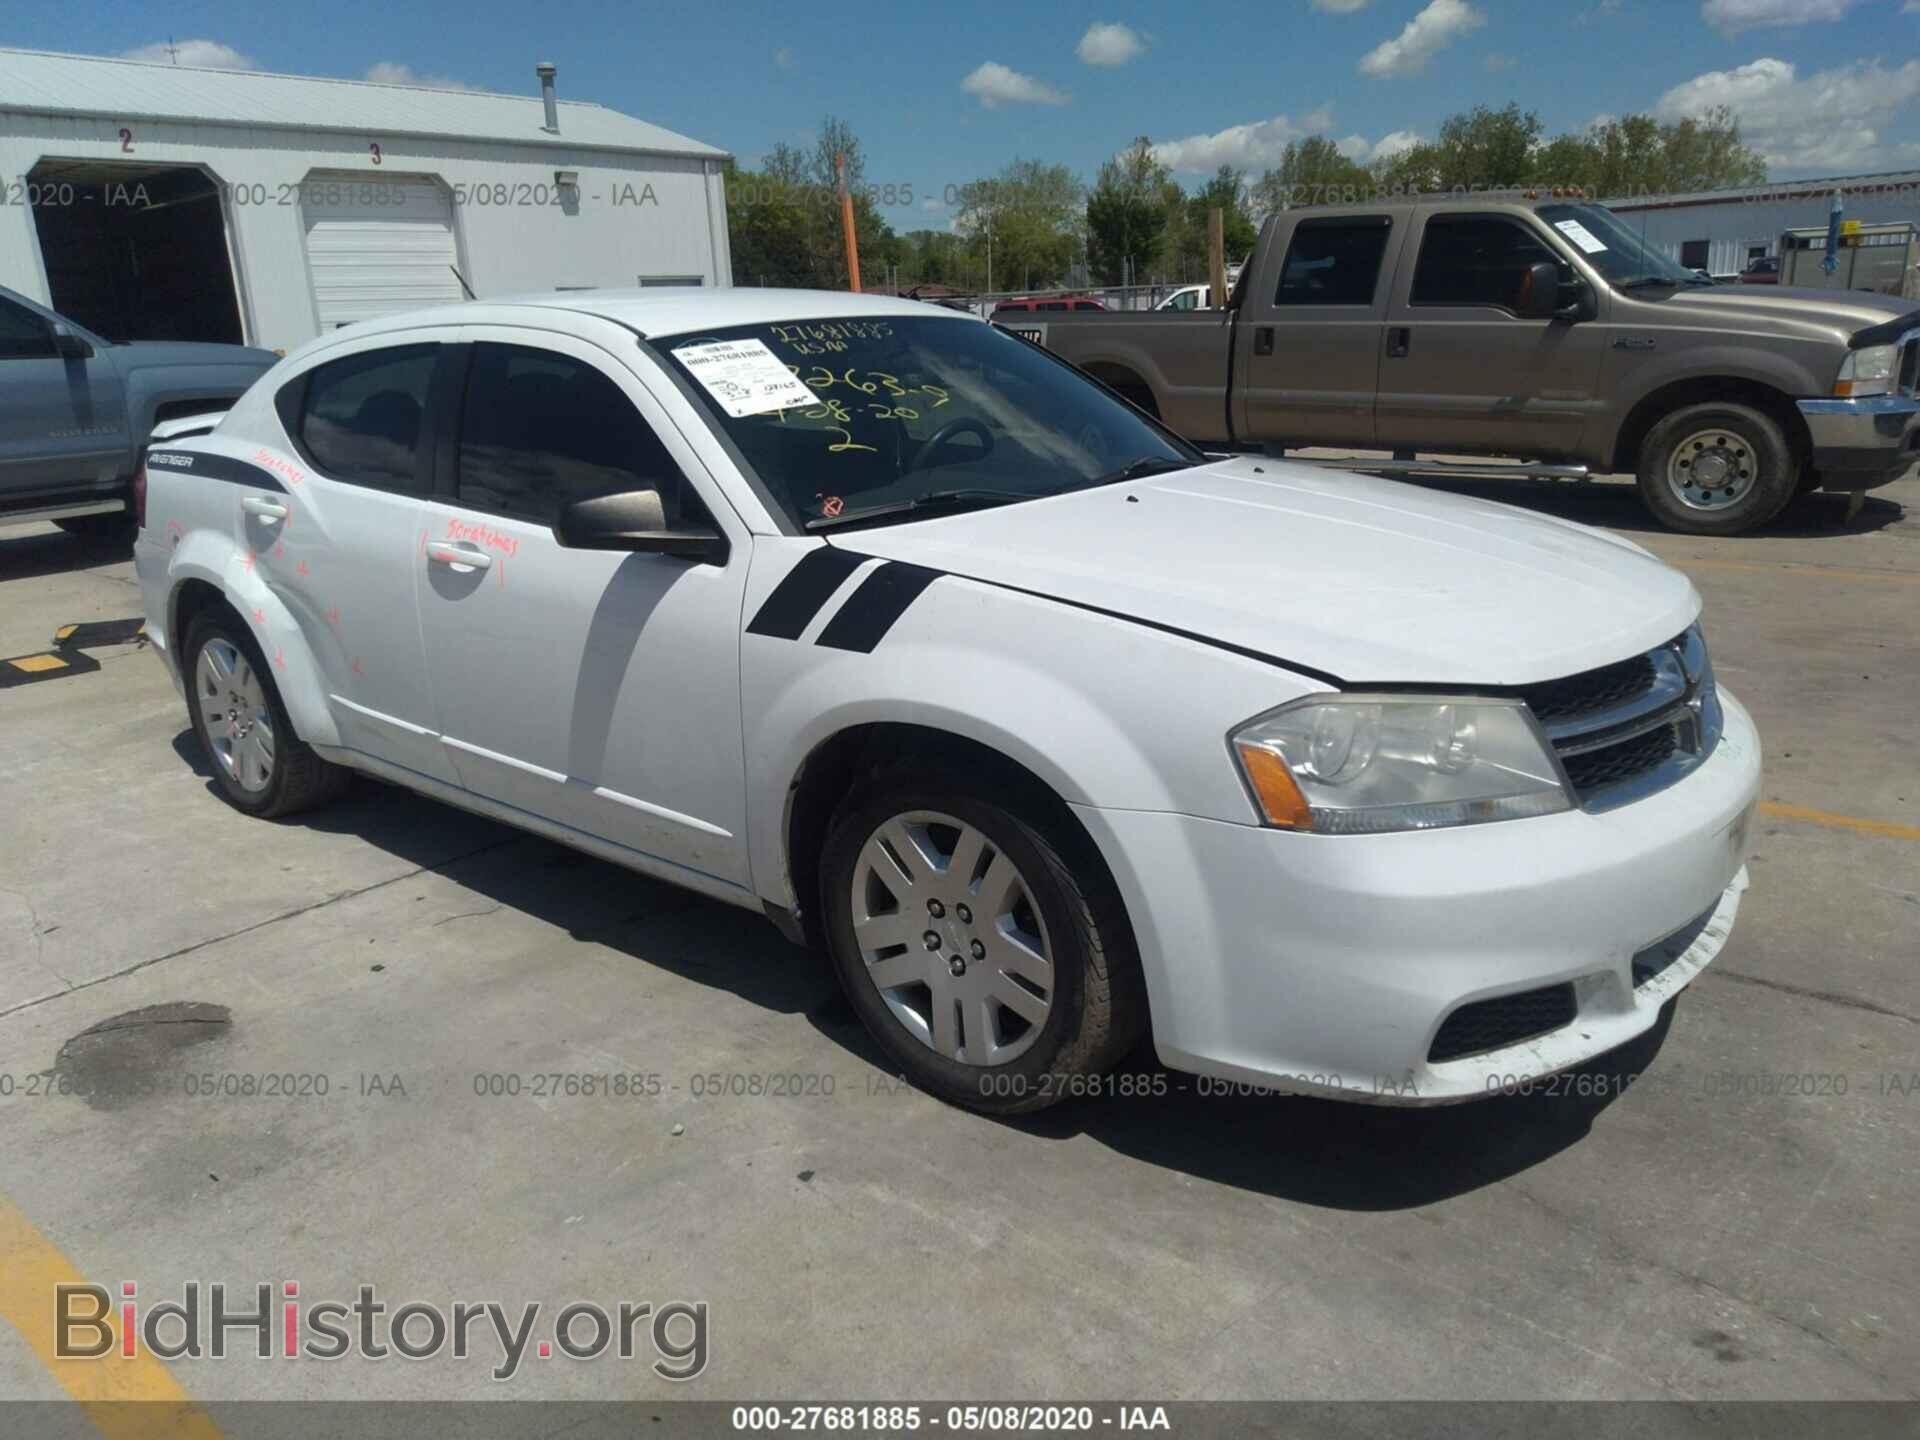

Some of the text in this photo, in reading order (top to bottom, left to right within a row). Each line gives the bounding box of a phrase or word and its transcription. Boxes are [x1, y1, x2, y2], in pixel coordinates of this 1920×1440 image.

[119, 128, 134, 152] 2
[370, 143, 382, 165] 3
[149, 453, 194, 467] AVENGER
